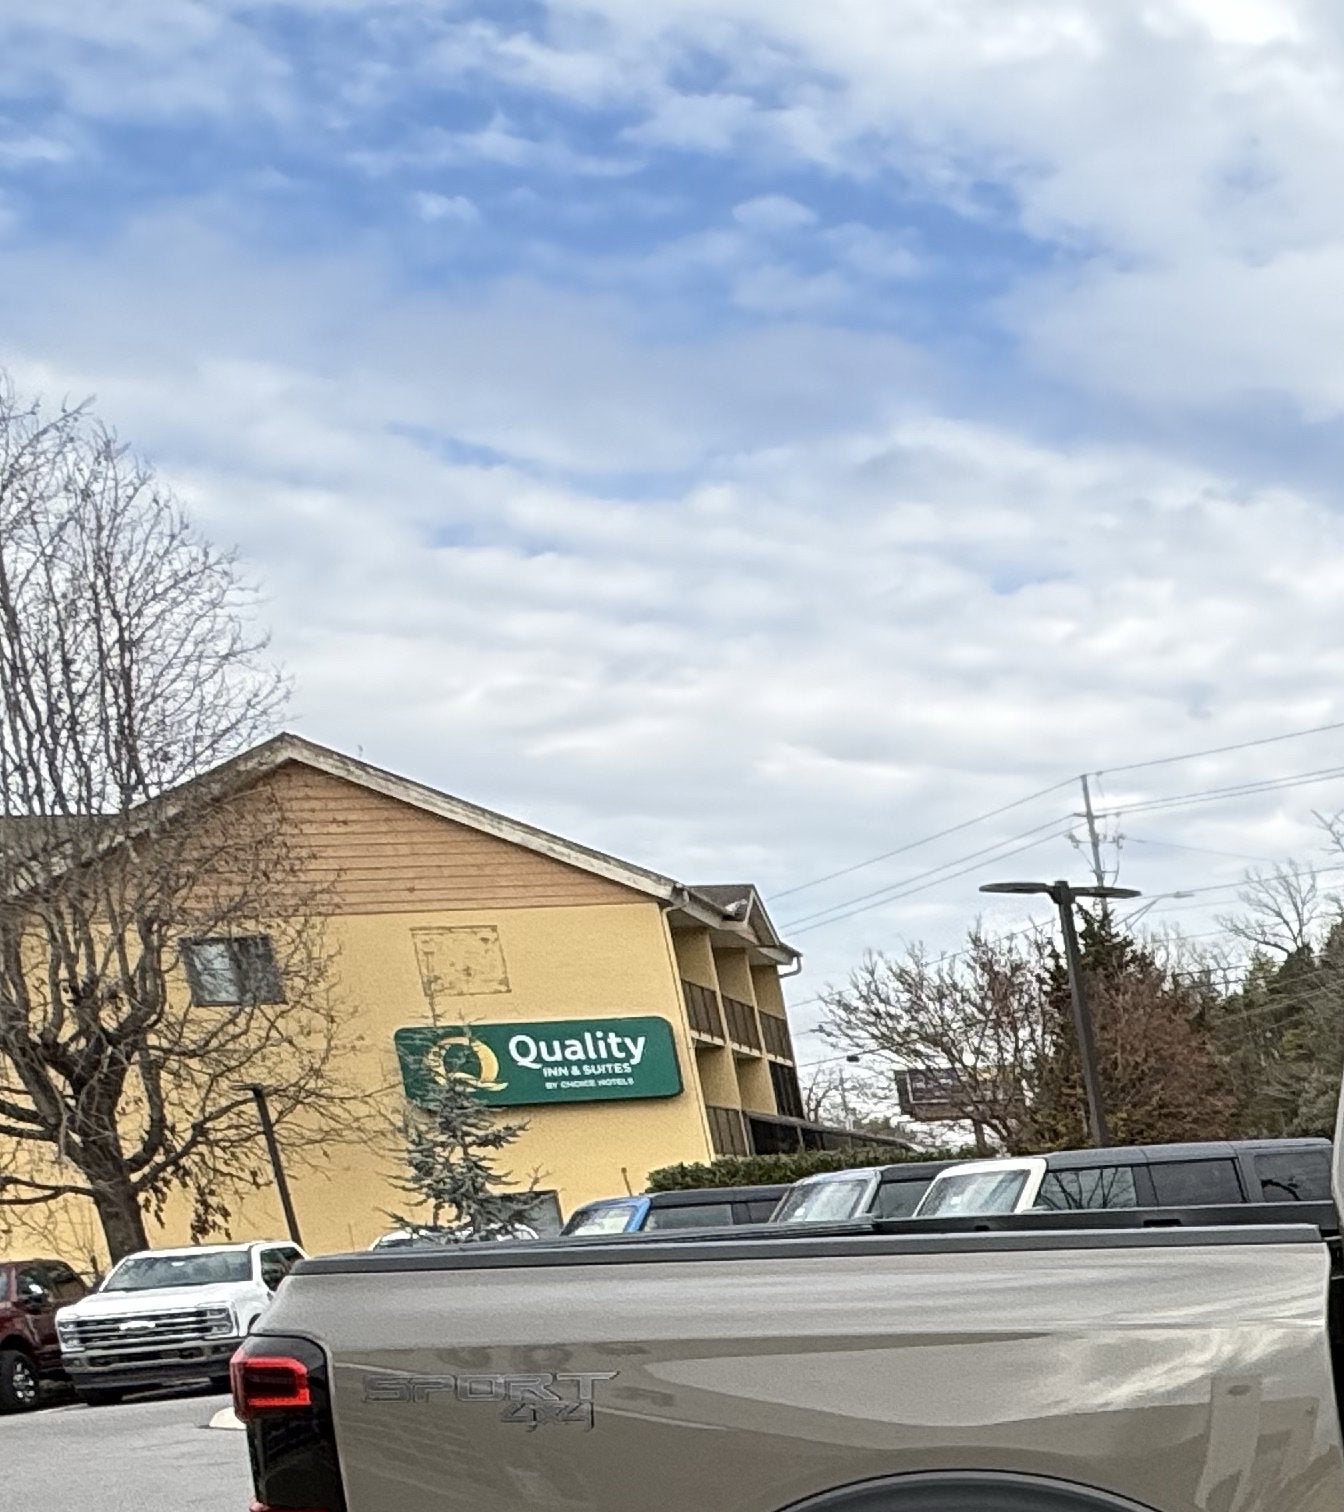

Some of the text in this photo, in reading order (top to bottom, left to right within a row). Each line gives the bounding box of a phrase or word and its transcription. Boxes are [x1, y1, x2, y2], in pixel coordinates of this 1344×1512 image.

[508, 1030, 646, 1069] Quality
[542, 1062, 632, 1077] INN & SUITES
[364, 1369, 622, 1402] SPORT
